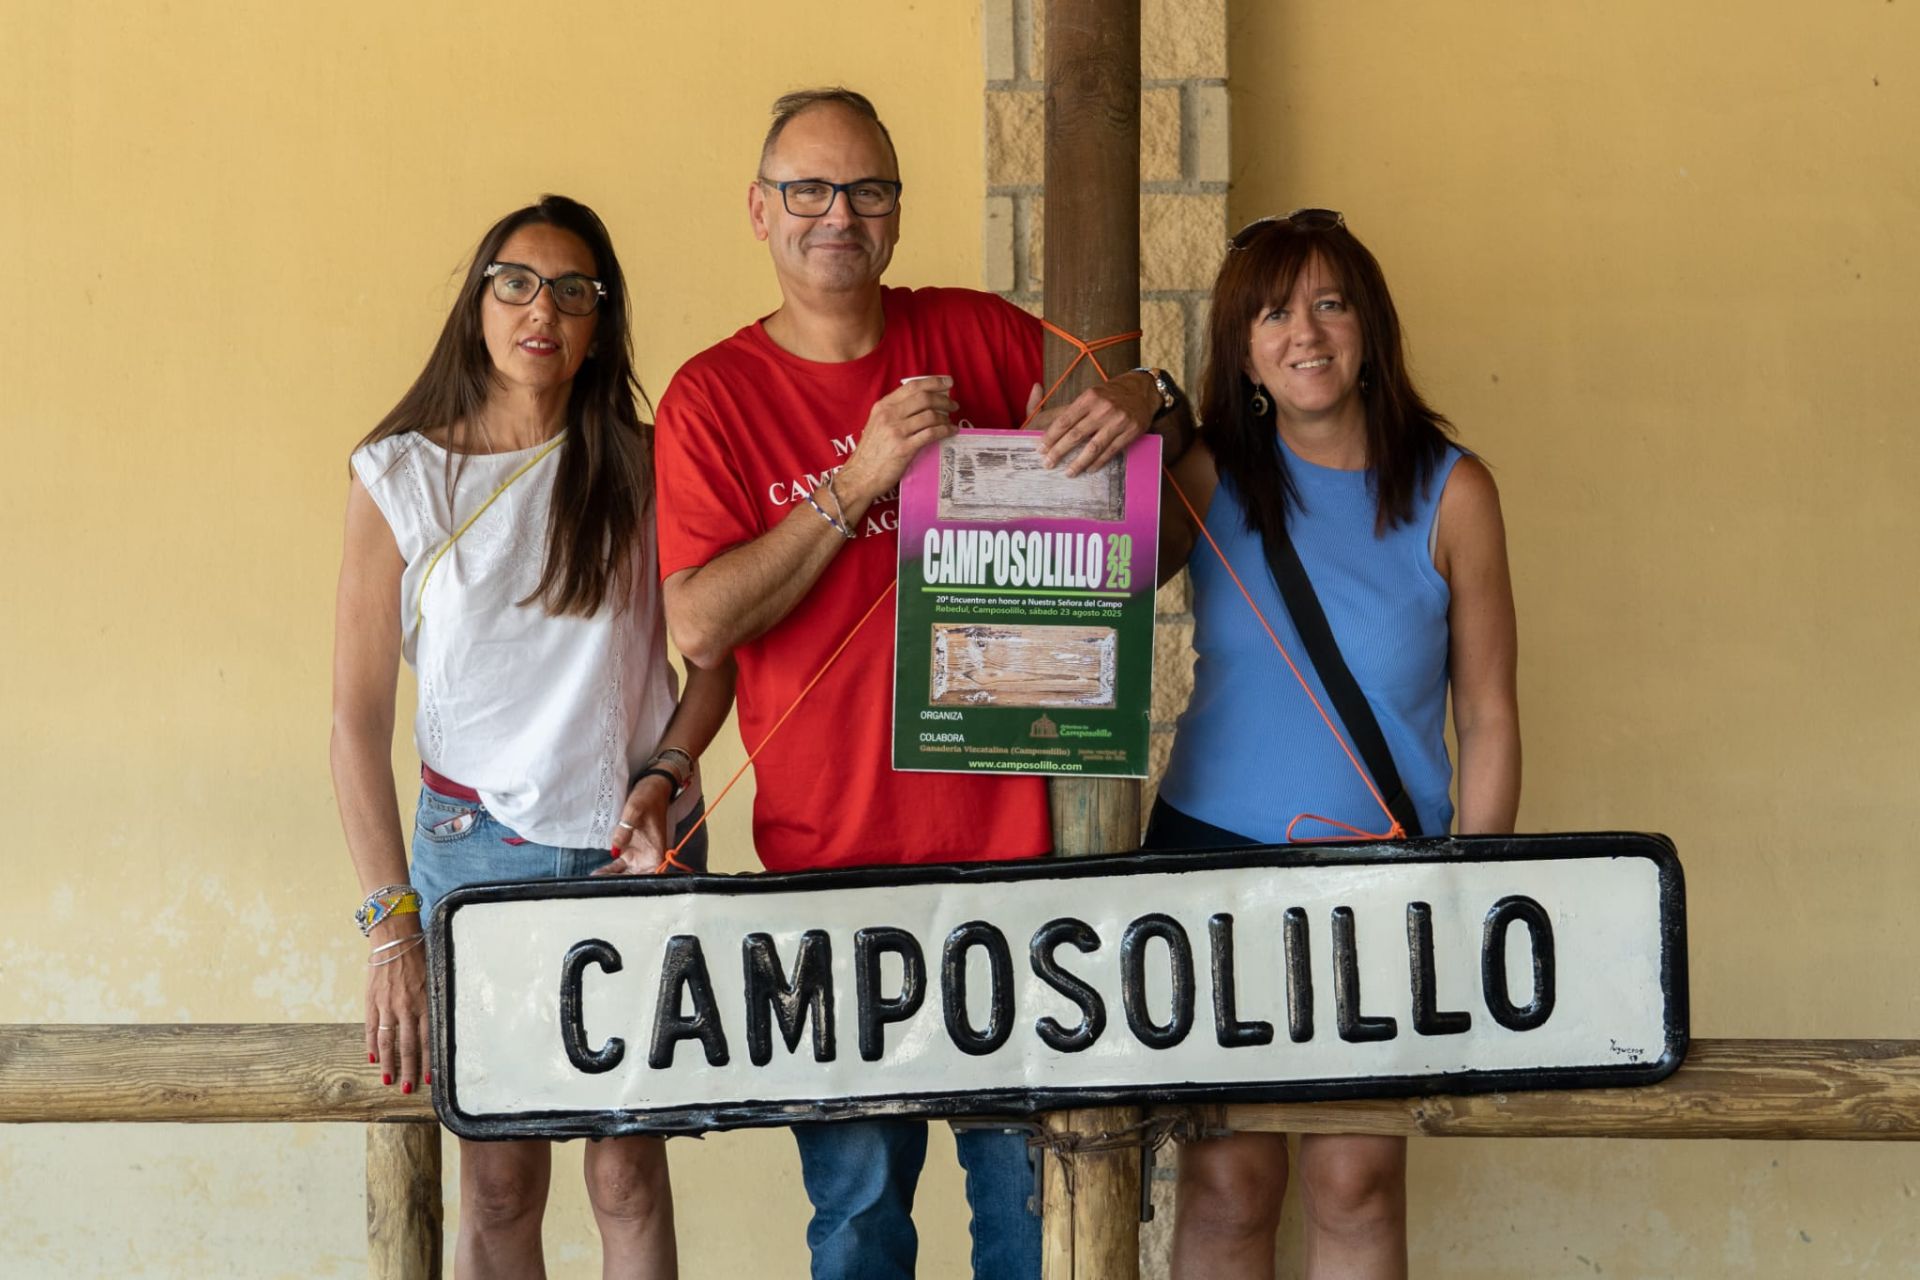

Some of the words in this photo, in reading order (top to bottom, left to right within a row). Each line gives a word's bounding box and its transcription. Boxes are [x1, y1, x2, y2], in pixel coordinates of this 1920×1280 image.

[1107, 534, 1132, 562] 20
[923, 528, 1104, 589] CAMPOSOLILLO
[1106, 560, 1131, 589] 25
[950, 596, 986, 605] Encuentro
[998, 597, 1020, 606] honor
[1028, 598, 1056, 607] Nuestra
[1057, 599, 1082, 608] Señora
[1083, 599, 1096, 608] del
[1097, 600, 1123, 611] Campo
[972, 605, 1027, 615] Camposolillo,
[1029, 607, 1058, 616] sábado
[1060, 608, 1071, 616] 23
[1072, 610, 1101, 618] agosto
[1102, 609, 1123, 618] 2025
[920, 710, 964, 721] ORGANIZA
[919, 732, 965, 743] COLABORA
[968, 760, 1082, 771] www.camposolillo.com
[560, 894, 1556, 1074] CAMPOSOLILLO
